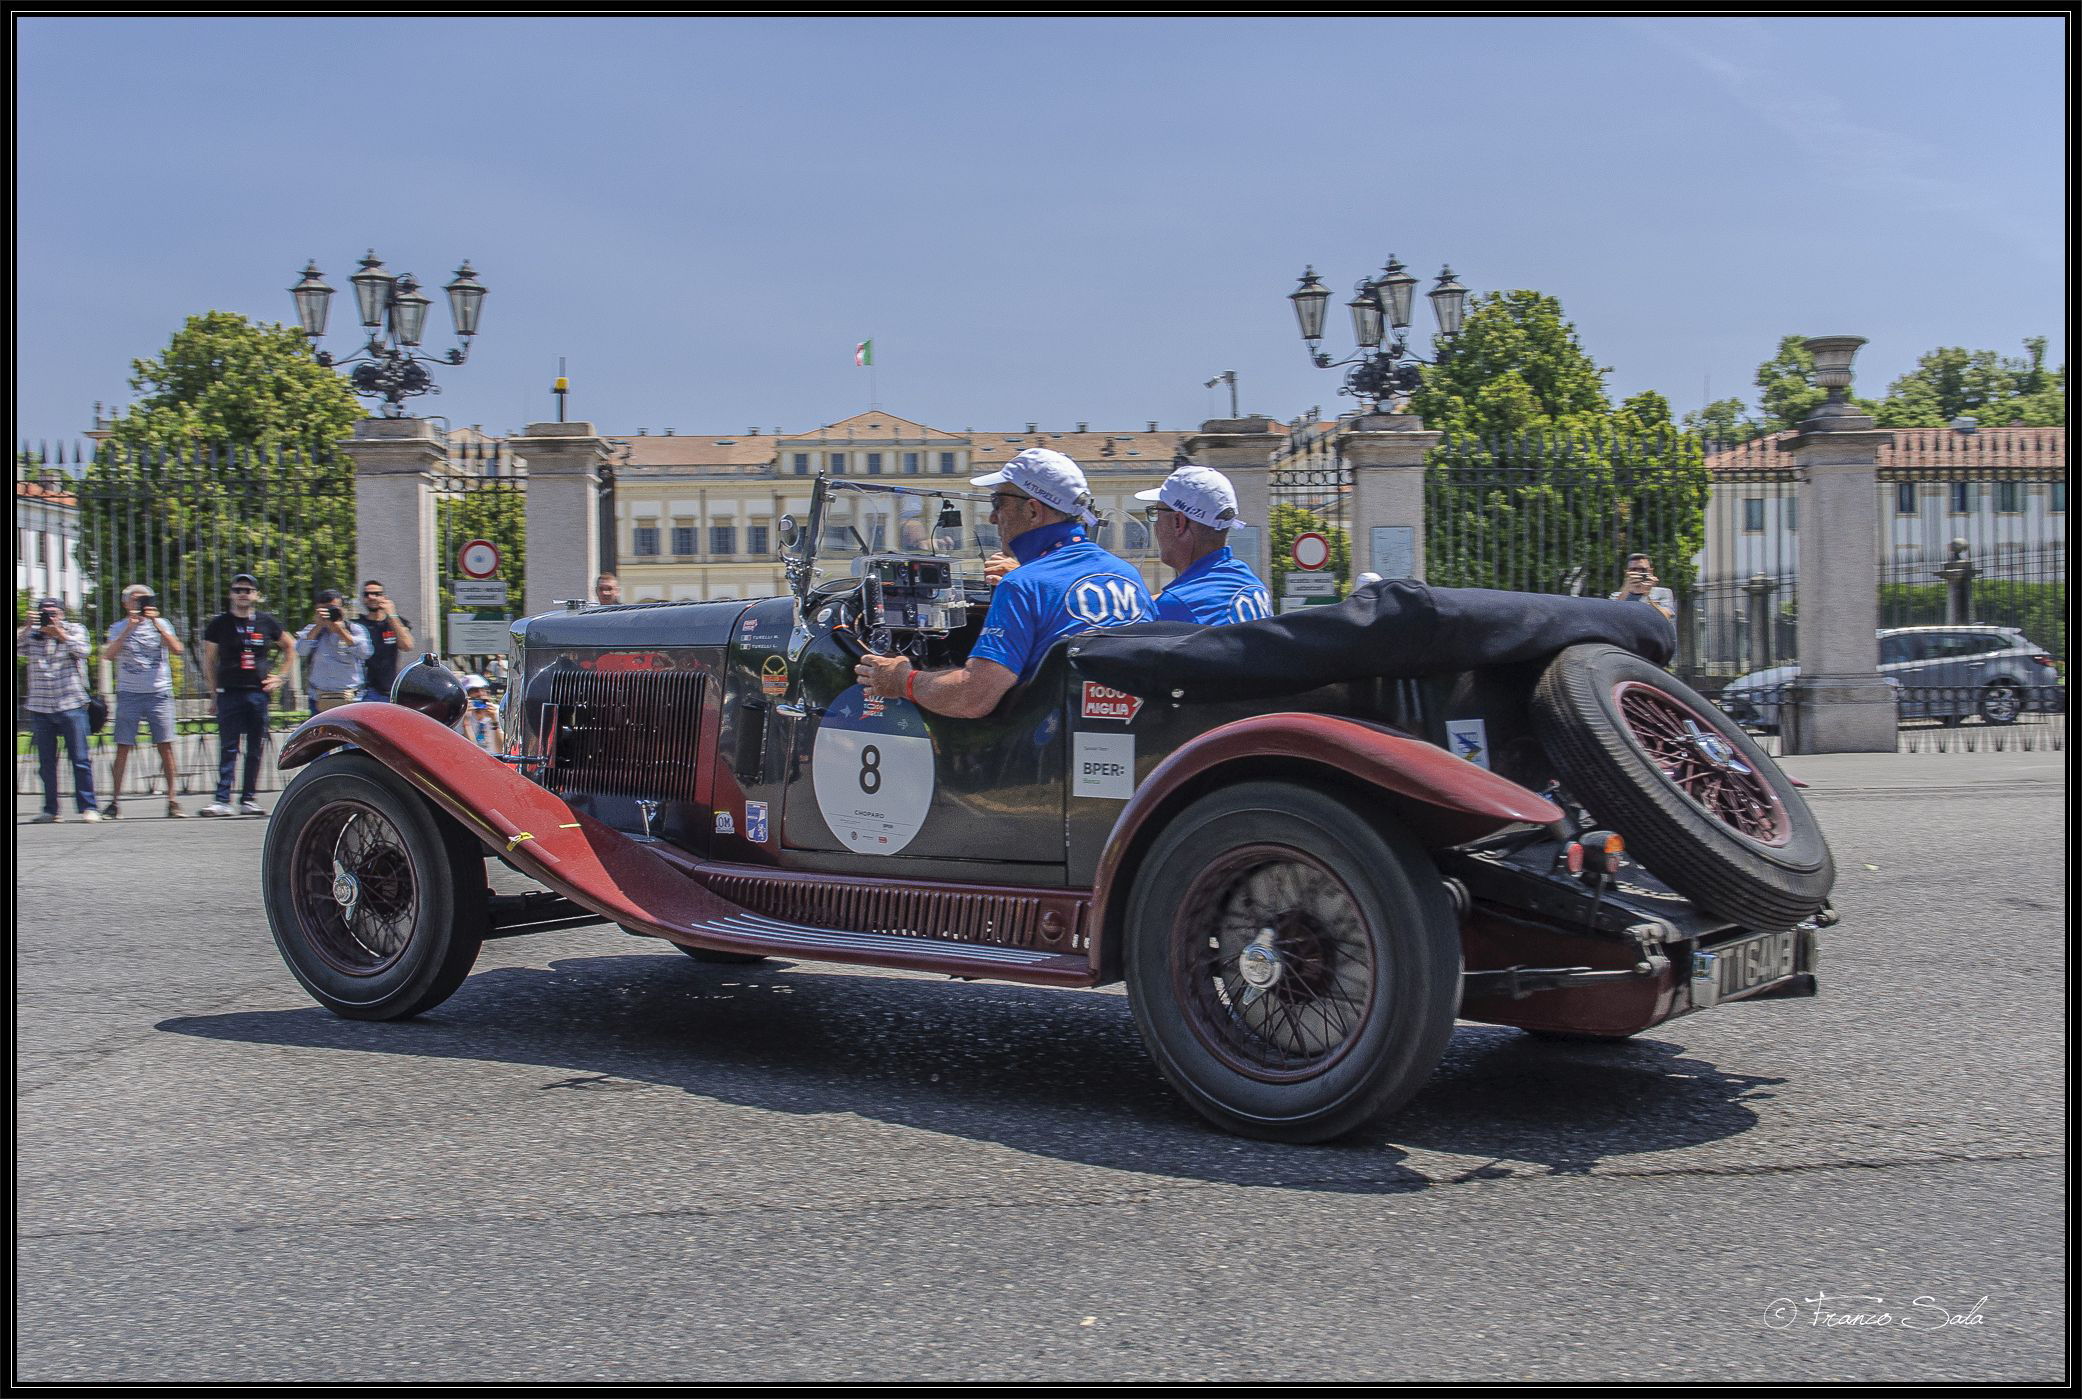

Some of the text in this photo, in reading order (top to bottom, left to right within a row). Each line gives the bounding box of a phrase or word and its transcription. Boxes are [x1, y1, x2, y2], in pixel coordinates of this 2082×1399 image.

[1075, 579, 1141, 624] OM
[1233, 589, 1273, 623] OM
[1089, 686, 1127, 699] 1000
[1086, 702, 1129, 715] MIGLIA
[858, 744, 882, 795] 8
[718, 816, 731, 828] OM
